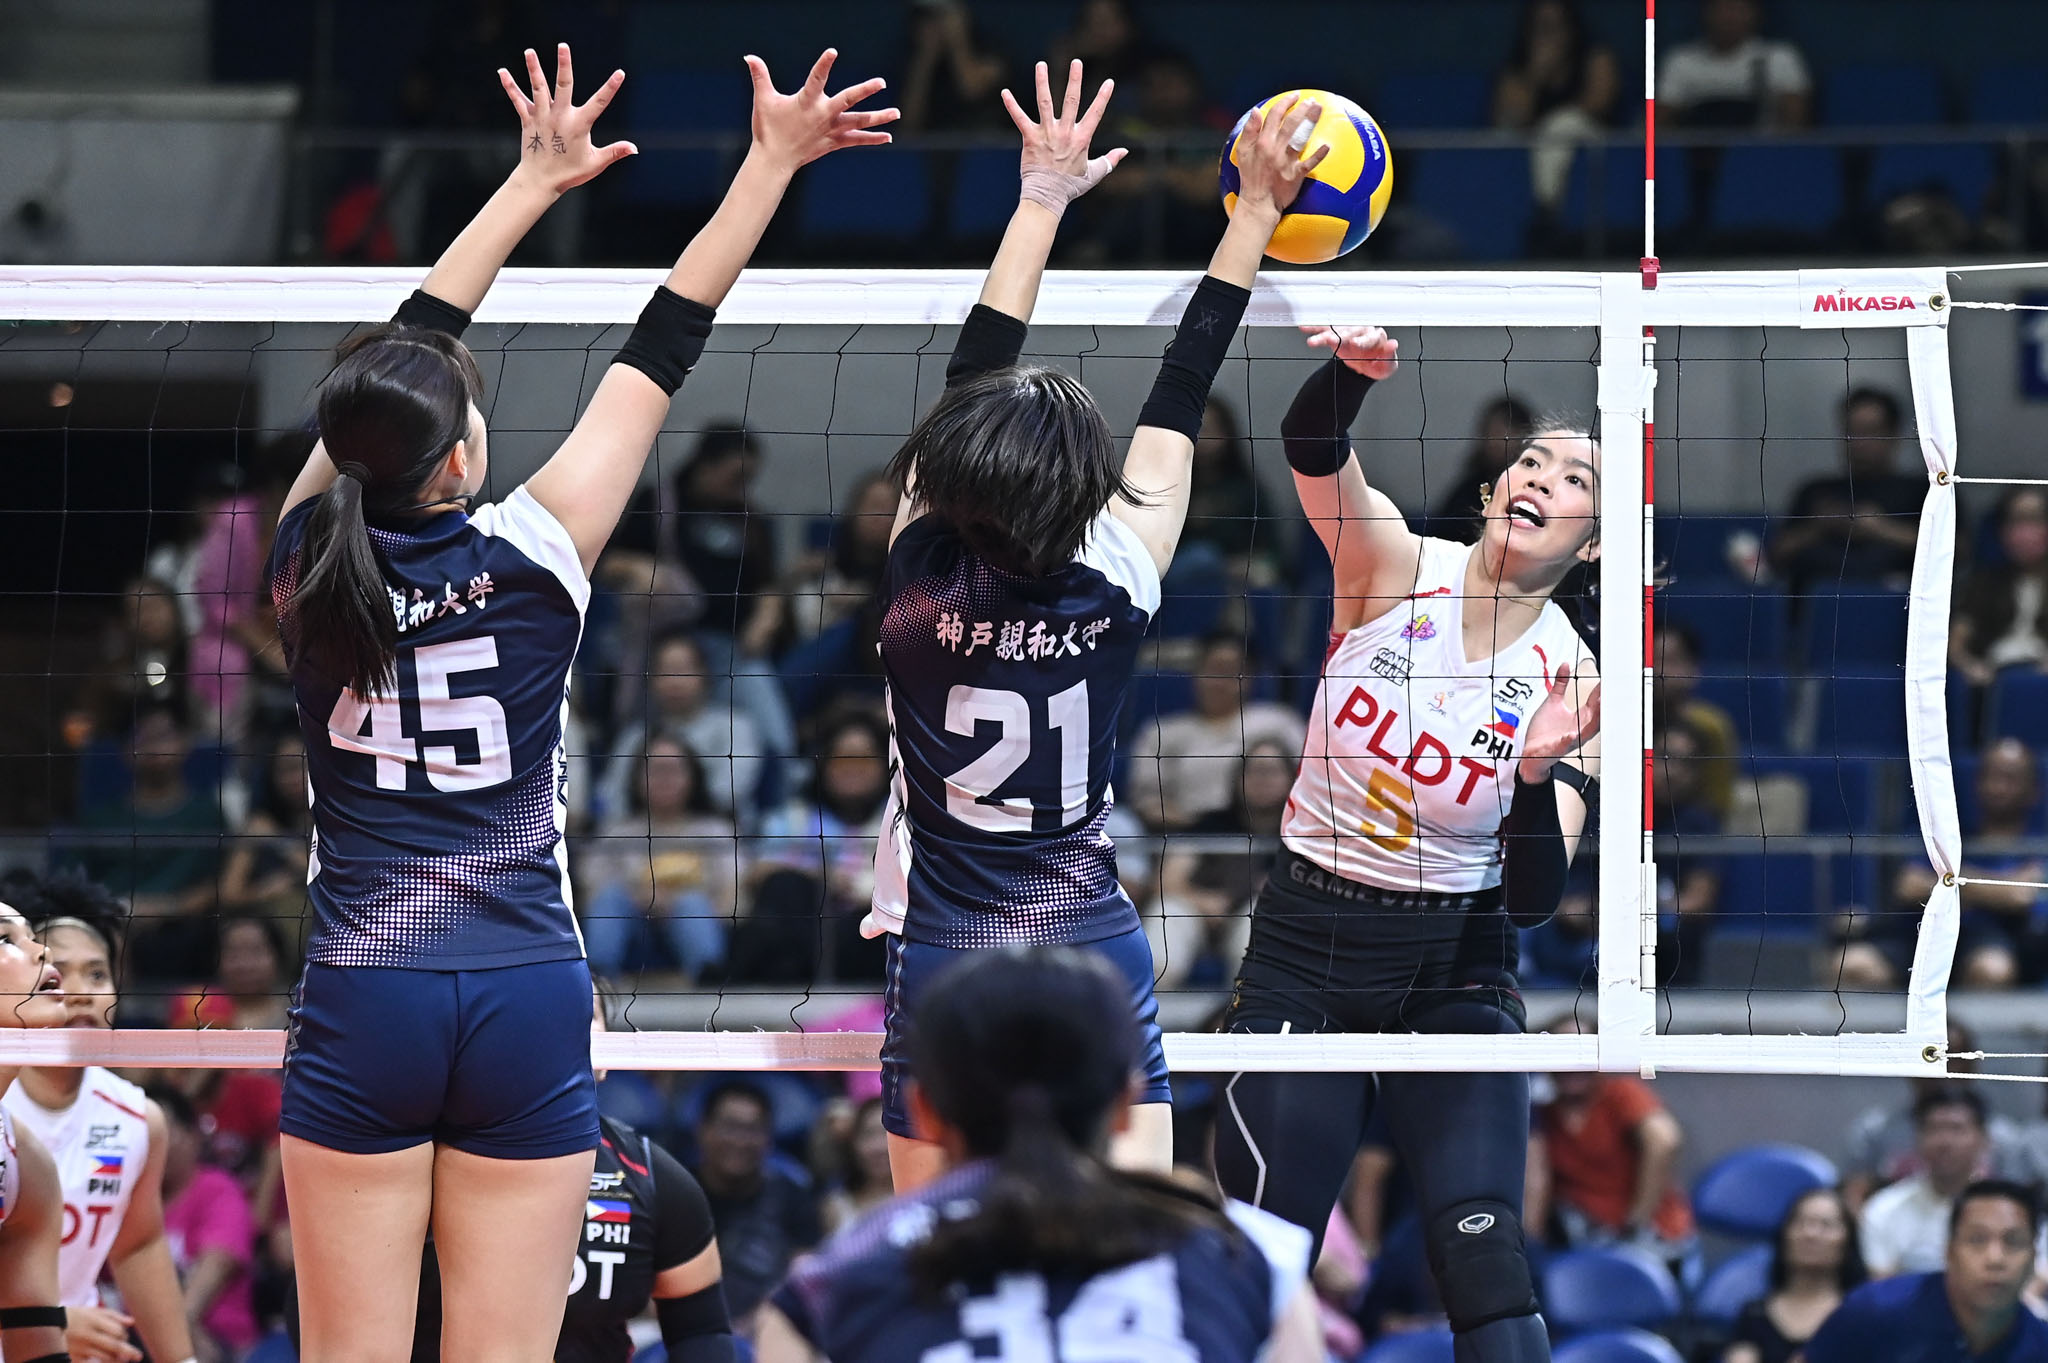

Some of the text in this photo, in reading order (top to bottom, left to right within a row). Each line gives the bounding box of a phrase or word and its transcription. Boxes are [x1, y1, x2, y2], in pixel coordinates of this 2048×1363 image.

[526, 130, 567, 156] 本気
[1813, 293, 1917, 312] MIKASA
[936, 611, 1110, 661] 神戸親和大学
[328, 636, 512, 793] 45
[944, 678, 1090, 832] 21
[1334, 685, 1495, 806] PLDT
[1471, 728, 1513, 761] PHI
[1360, 767, 1414, 852] 5
[87, 1178, 121, 1196] PHI
[586, 1222, 630, 1244] PHI
